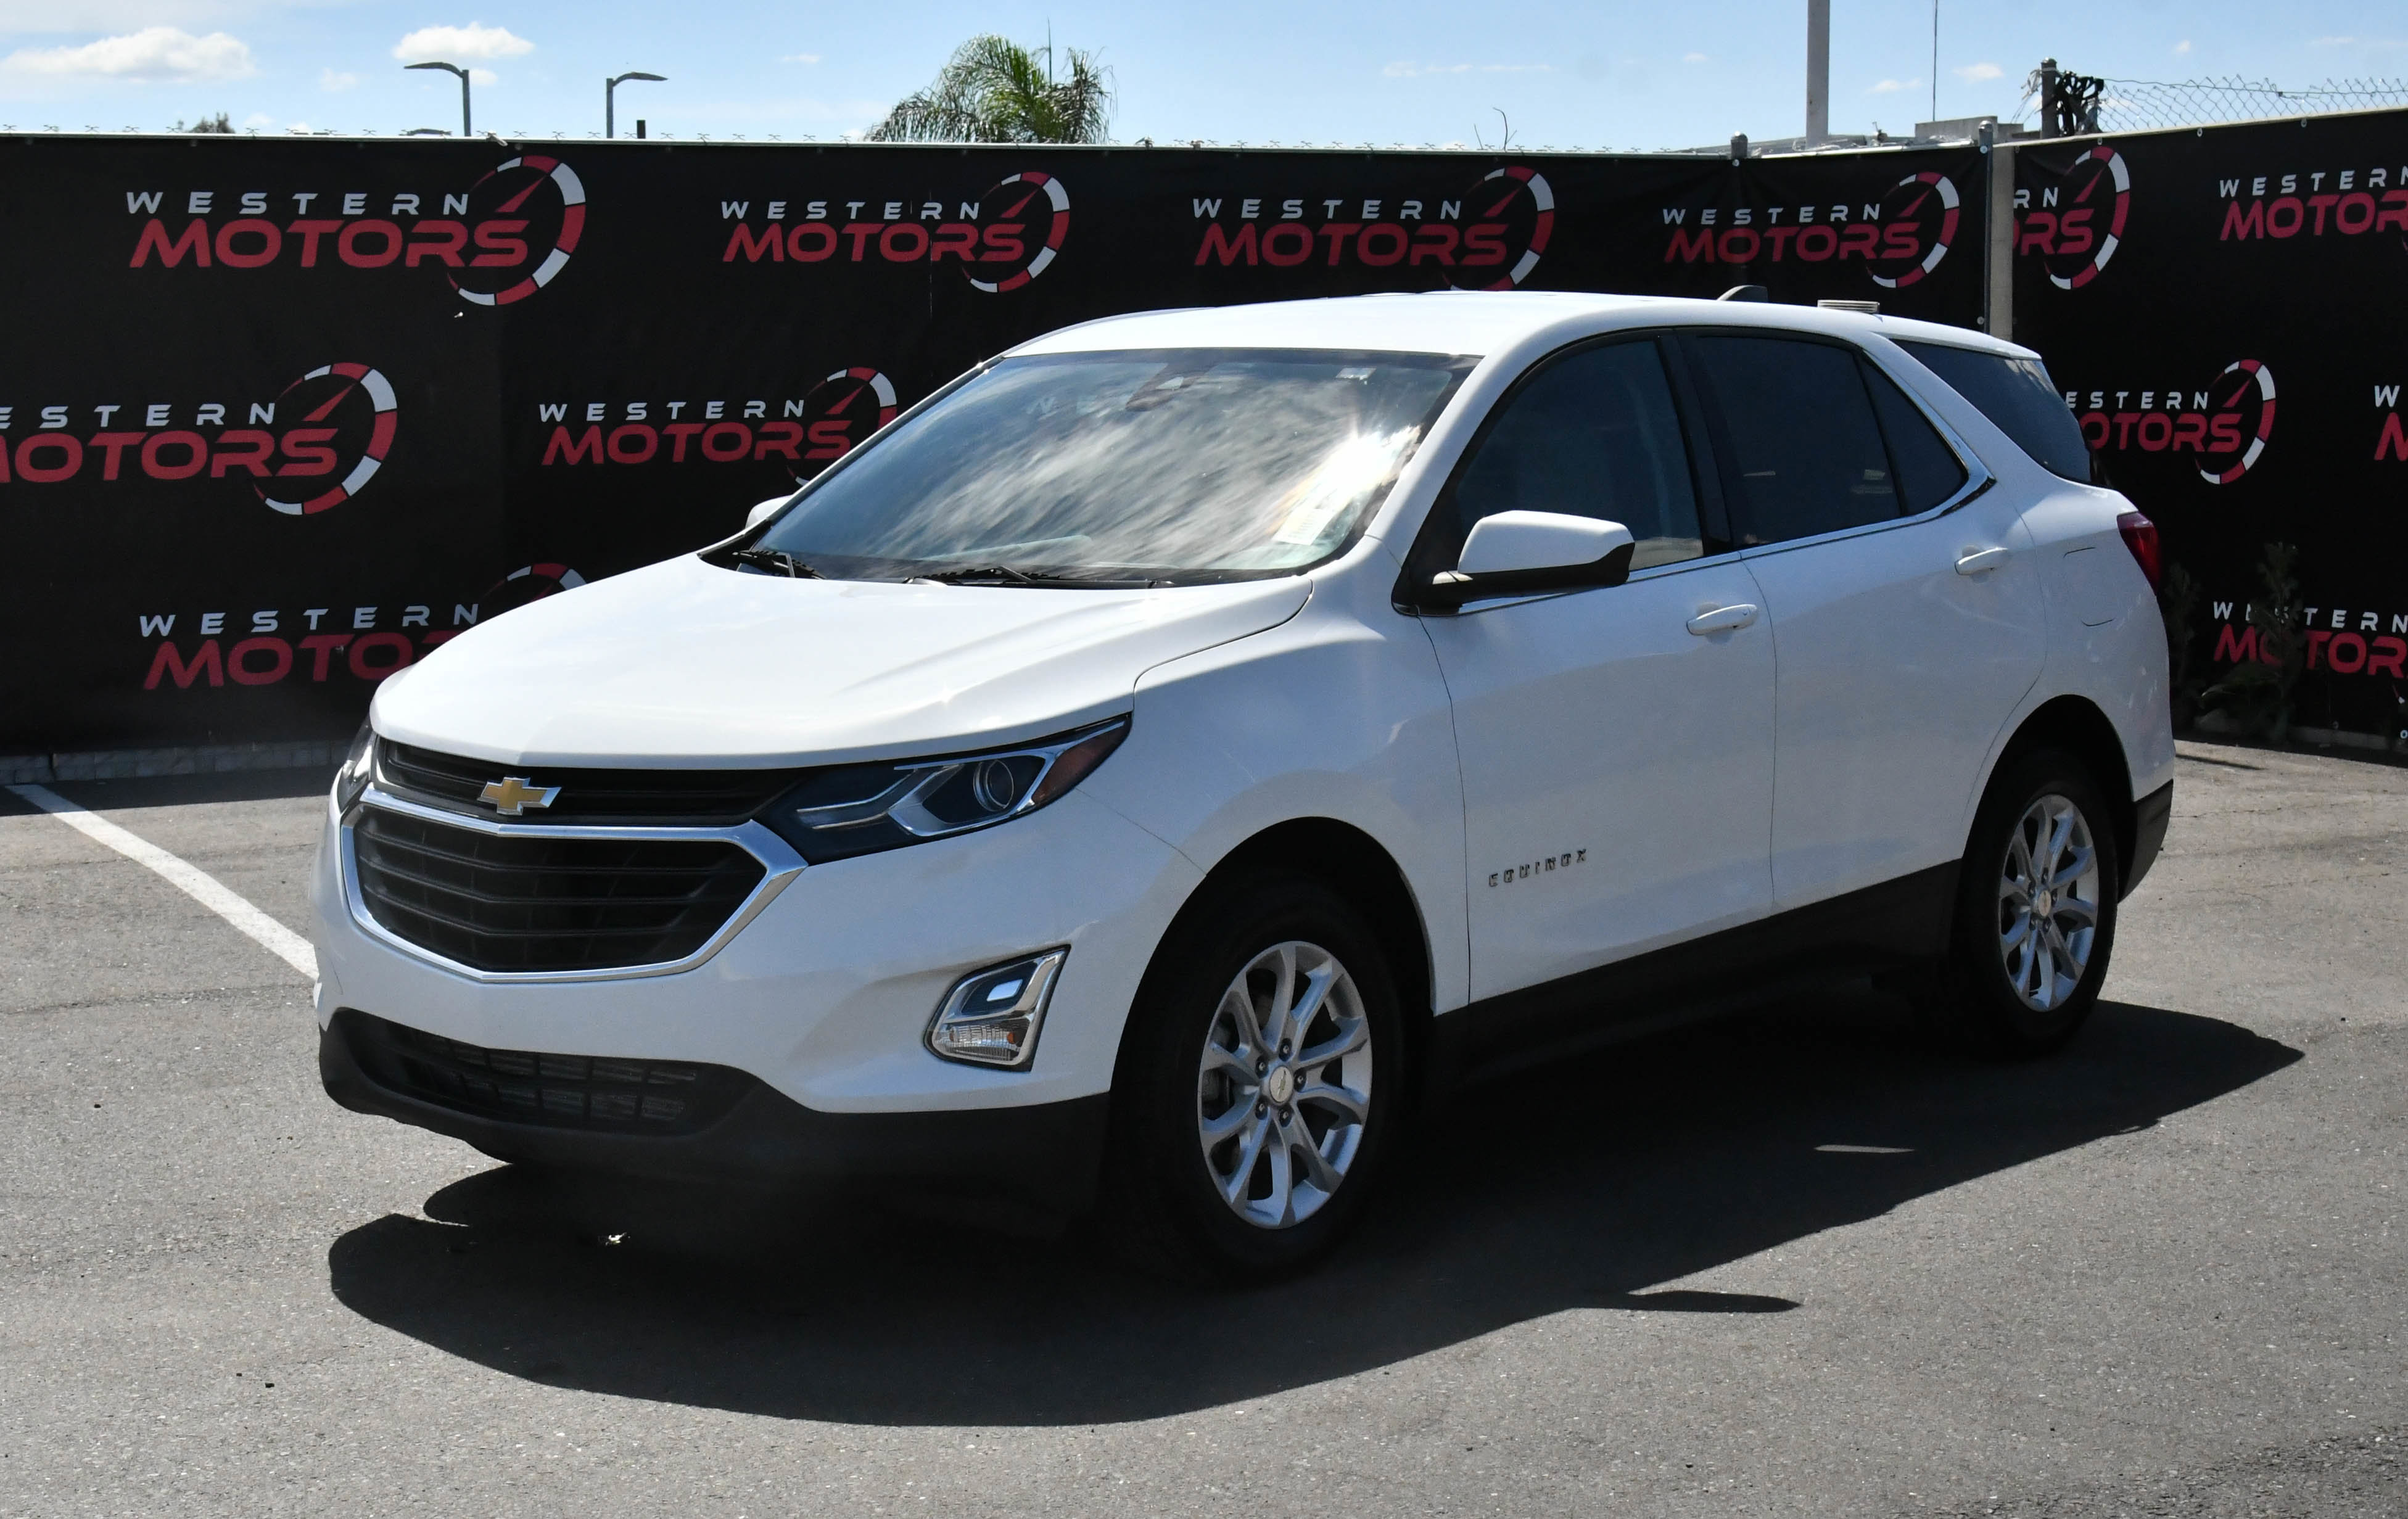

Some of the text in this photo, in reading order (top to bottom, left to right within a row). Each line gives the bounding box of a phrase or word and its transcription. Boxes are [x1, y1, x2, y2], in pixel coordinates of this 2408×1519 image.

[126, 192, 468, 215] WESTERN
[721, 201, 979, 220] WESTERN
[1193, 199, 1461, 219] WESTERN
[1663, 204, 1880, 224] WESTERN
[2220, 189, 2408, 241] MOTOR
[130, 218, 529, 268] MOTORS
[723, 223, 1025, 262] MOTORS
[1195, 223, 1506, 265] MOTORS
[1665, 223, 1919, 263] MOTORS
[0, 403, 275, 429] ESTERN
[539, 400, 804, 422] WESTERN
[2066, 392, 2208, 409] ESTERN
[542, 420, 852, 465] MOTORS
[2079, 412, 2242, 453] OTORS
[0, 428, 338, 483] OTORS
[139, 603, 479, 637] WESTERN
[144, 630, 465, 690] MOTO
[2214, 624, 2408, 678] MTOR
[1488, 849, 1586, 887] EQUINOX
